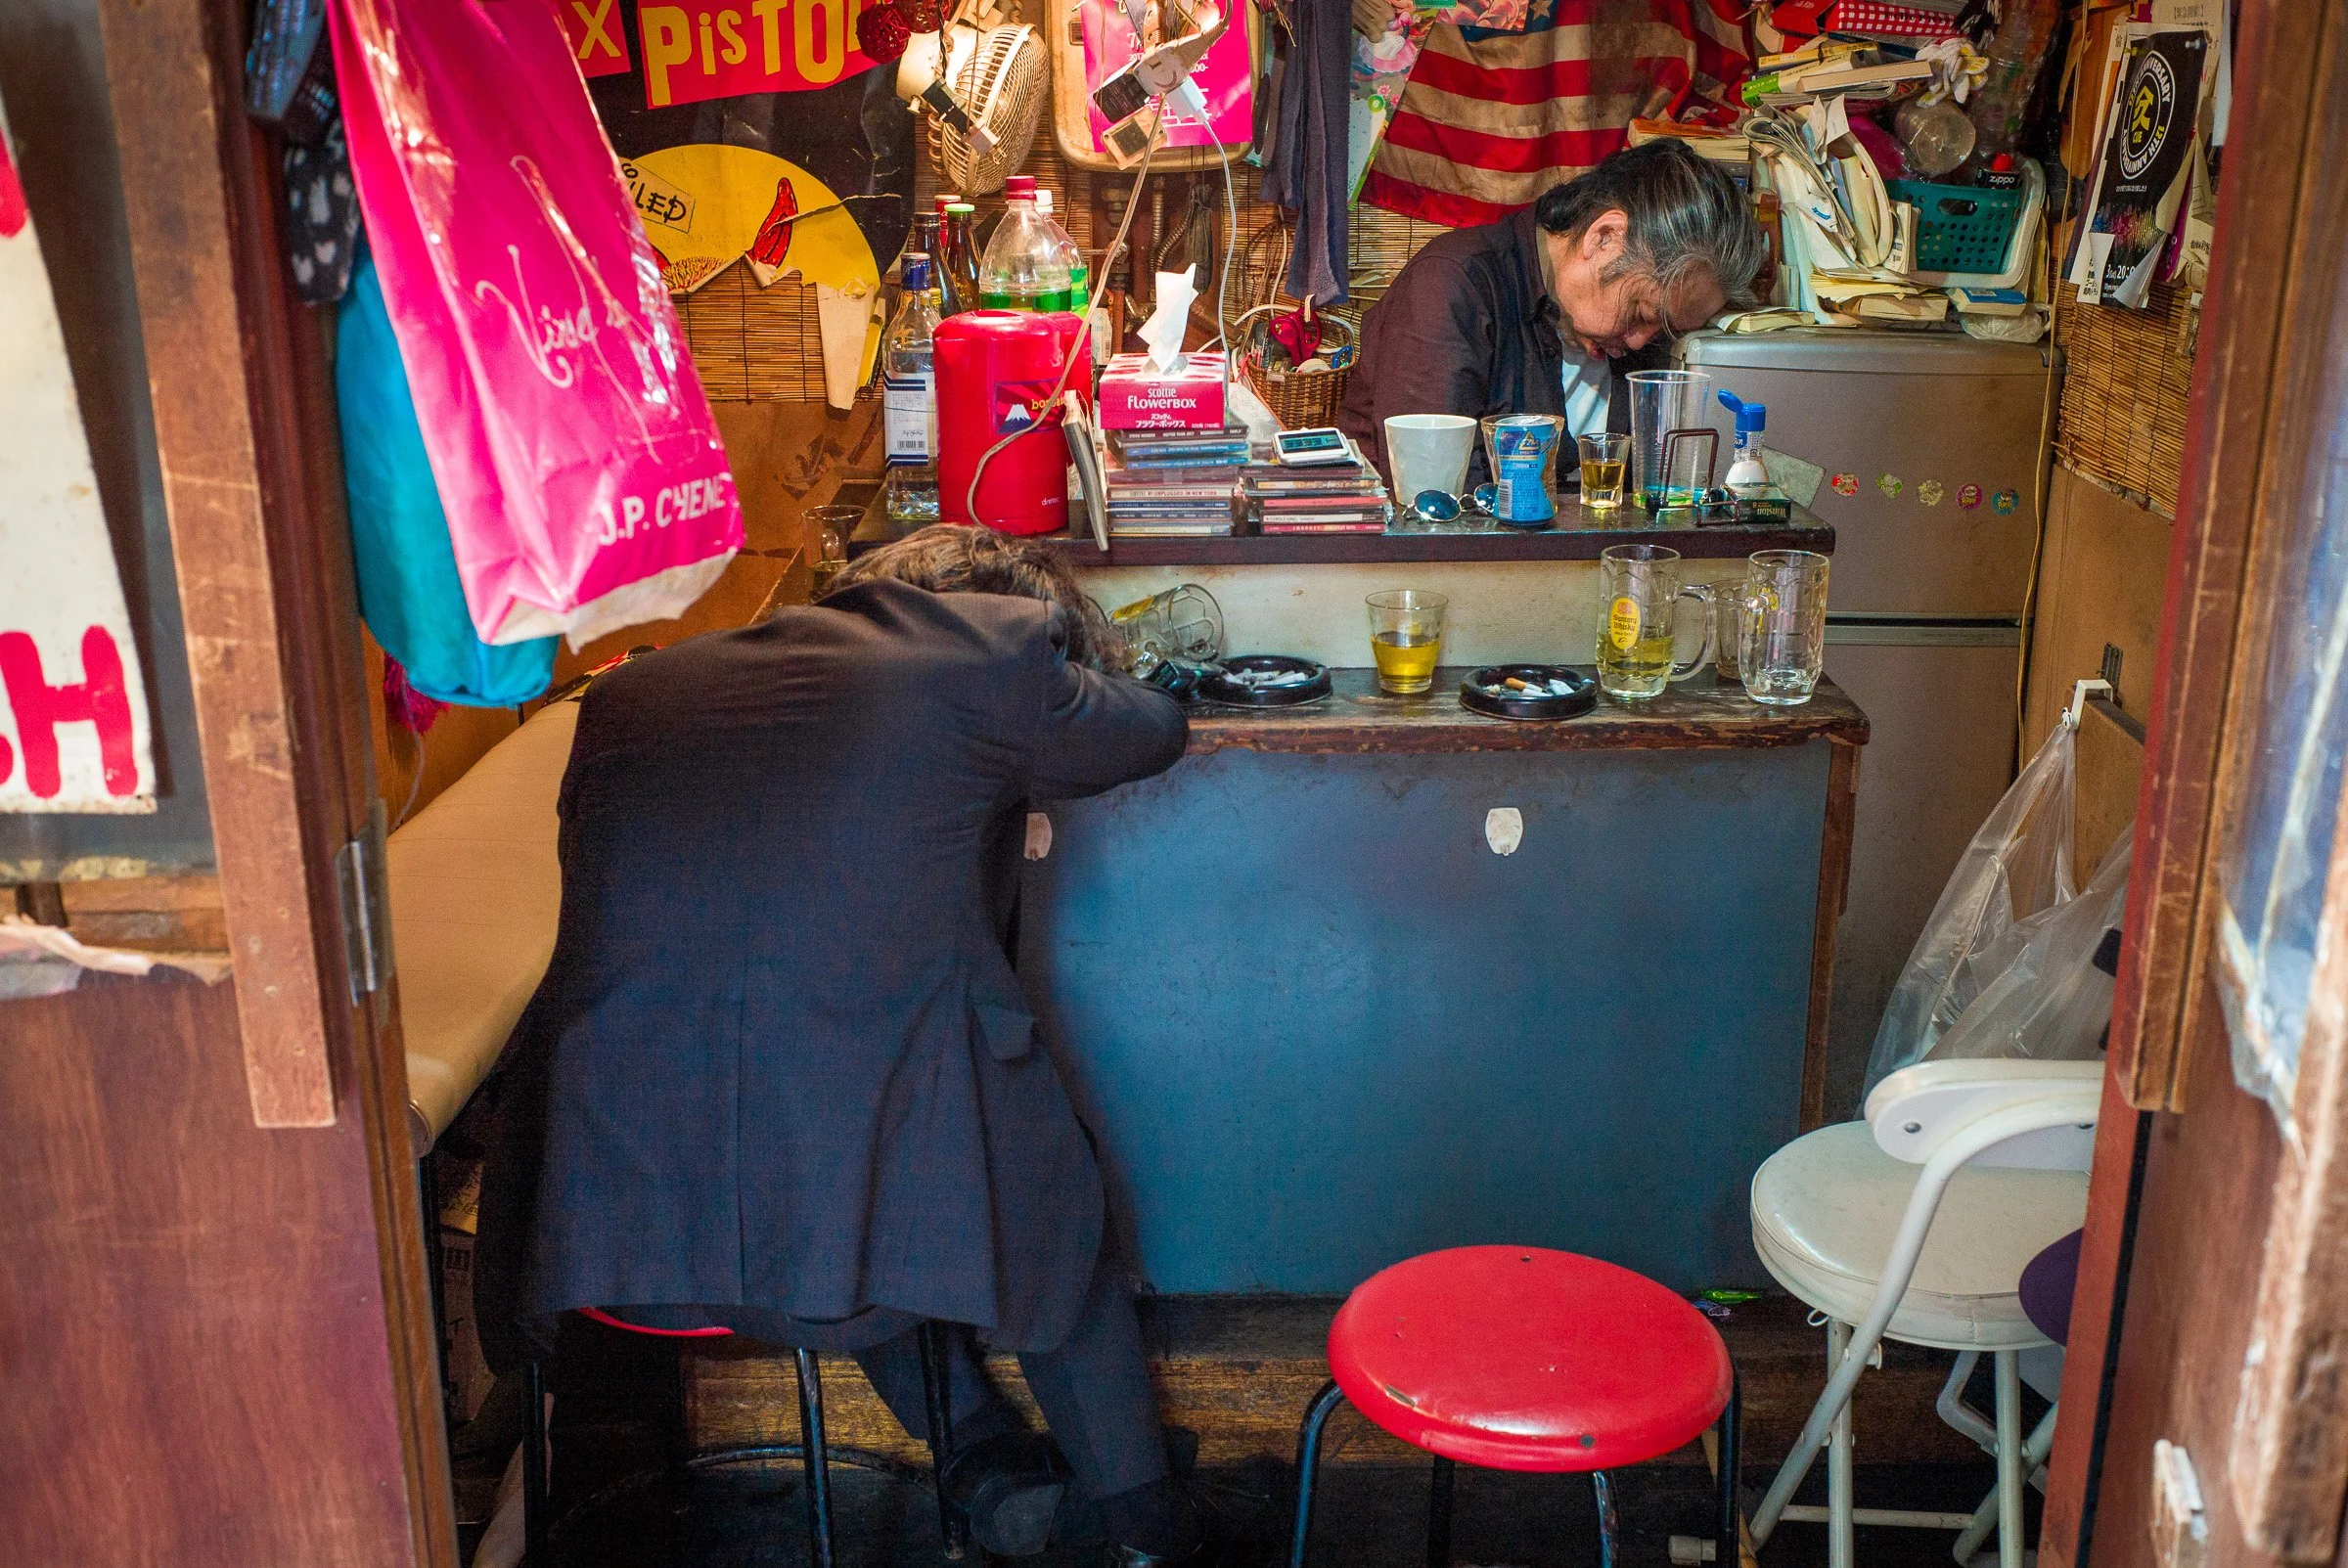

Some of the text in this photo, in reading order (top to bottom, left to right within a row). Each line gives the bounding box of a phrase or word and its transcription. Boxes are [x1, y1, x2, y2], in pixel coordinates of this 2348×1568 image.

[2132, 86, 2154, 132] 久
[1135, 420, 1186, 428] フラワーボックス
